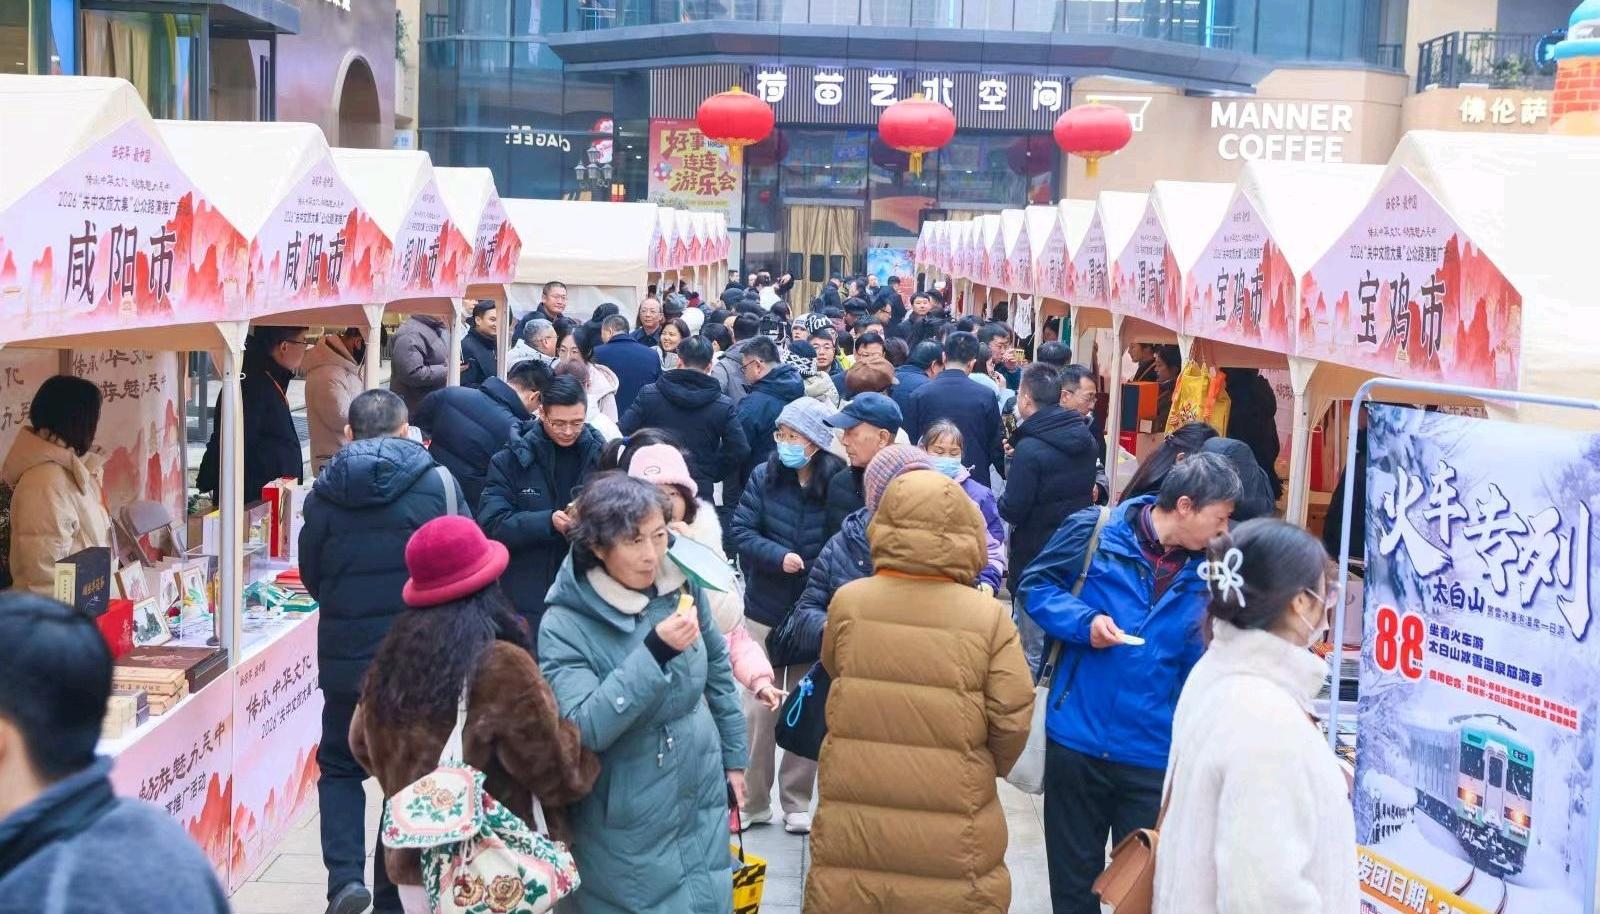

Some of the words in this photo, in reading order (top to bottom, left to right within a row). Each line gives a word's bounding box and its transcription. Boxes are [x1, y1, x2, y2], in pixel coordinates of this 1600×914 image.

[1210, 100, 1353, 132] MANNER
[661, 129, 706, 160] 好事
[683, 150, 717, 172] 连连
[1218, 133, 1345, 163] COFFEE
[670, 171, 737, 197] 游乐会
[64, 219, 178, 306] 咸阳市
[283, 230, 347, 292] 咸阳市
[1215, 266, 1265, 325] 宝鸡市
[1356, 269, 1446, 358] 宝鸡市
[1379, 459, 1593, 643] 火车专列
[1433, 577, 1485, 613] 太白山
[1376, 607, 1424, 680] 88
[1428, 640, 1543, 688] 太白山冰雪温泉旅游季
[245, 653, 312, 724] 传承中华文化
